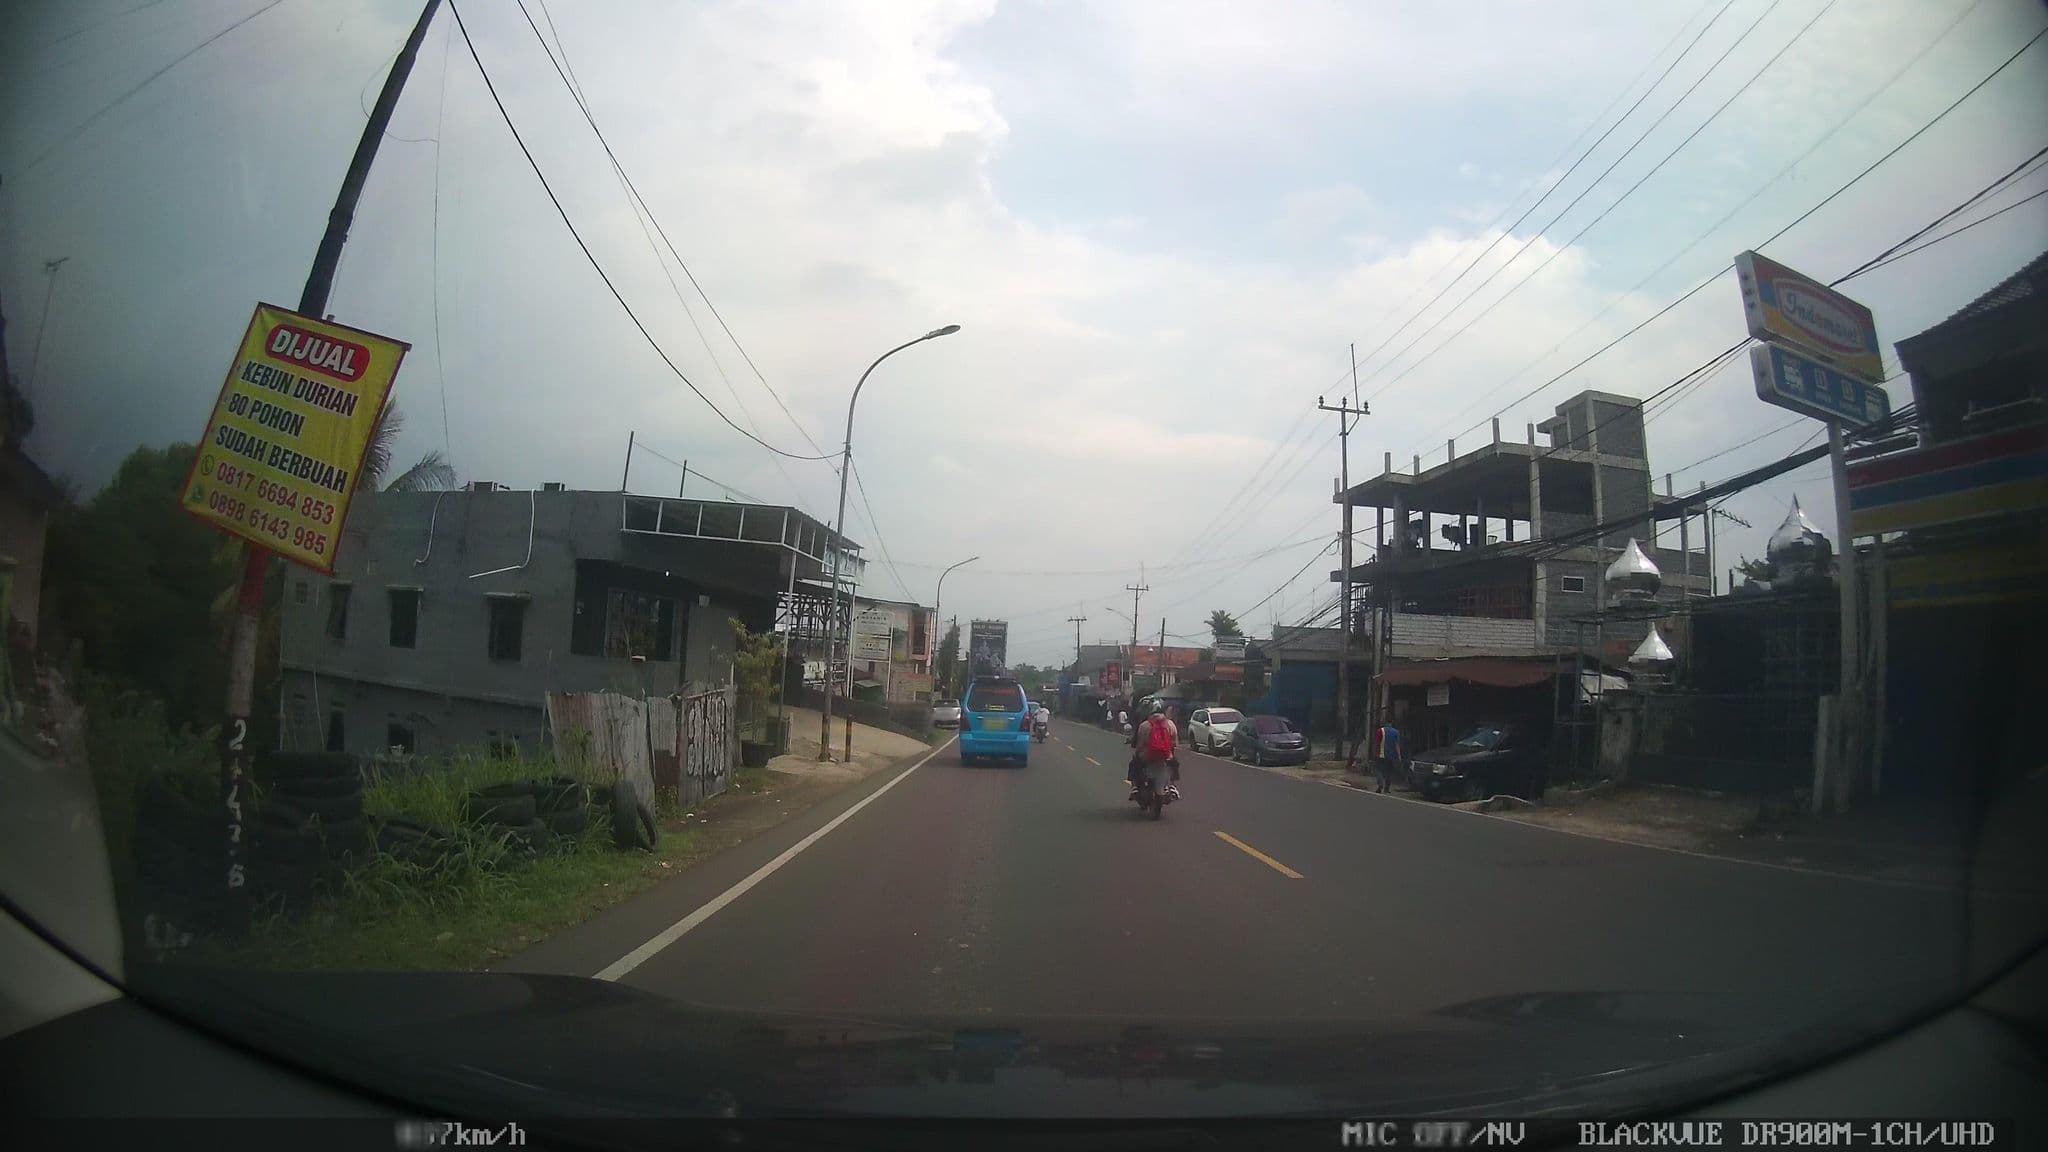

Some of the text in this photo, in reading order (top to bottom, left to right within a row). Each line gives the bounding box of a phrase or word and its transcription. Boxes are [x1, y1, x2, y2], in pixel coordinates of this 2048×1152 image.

[271, 328, 356, 377] DIJUAL
[228, 393, 306, 438] 80 POHON
[241, 361, 359, 417] KEBUN DURIAN
[216, 425, 349, 494] SUDAH BERBUAH
[209, 490, 327, 556] 0898 6143 985
[217, 462, 336, 525] 0817 6694 853
